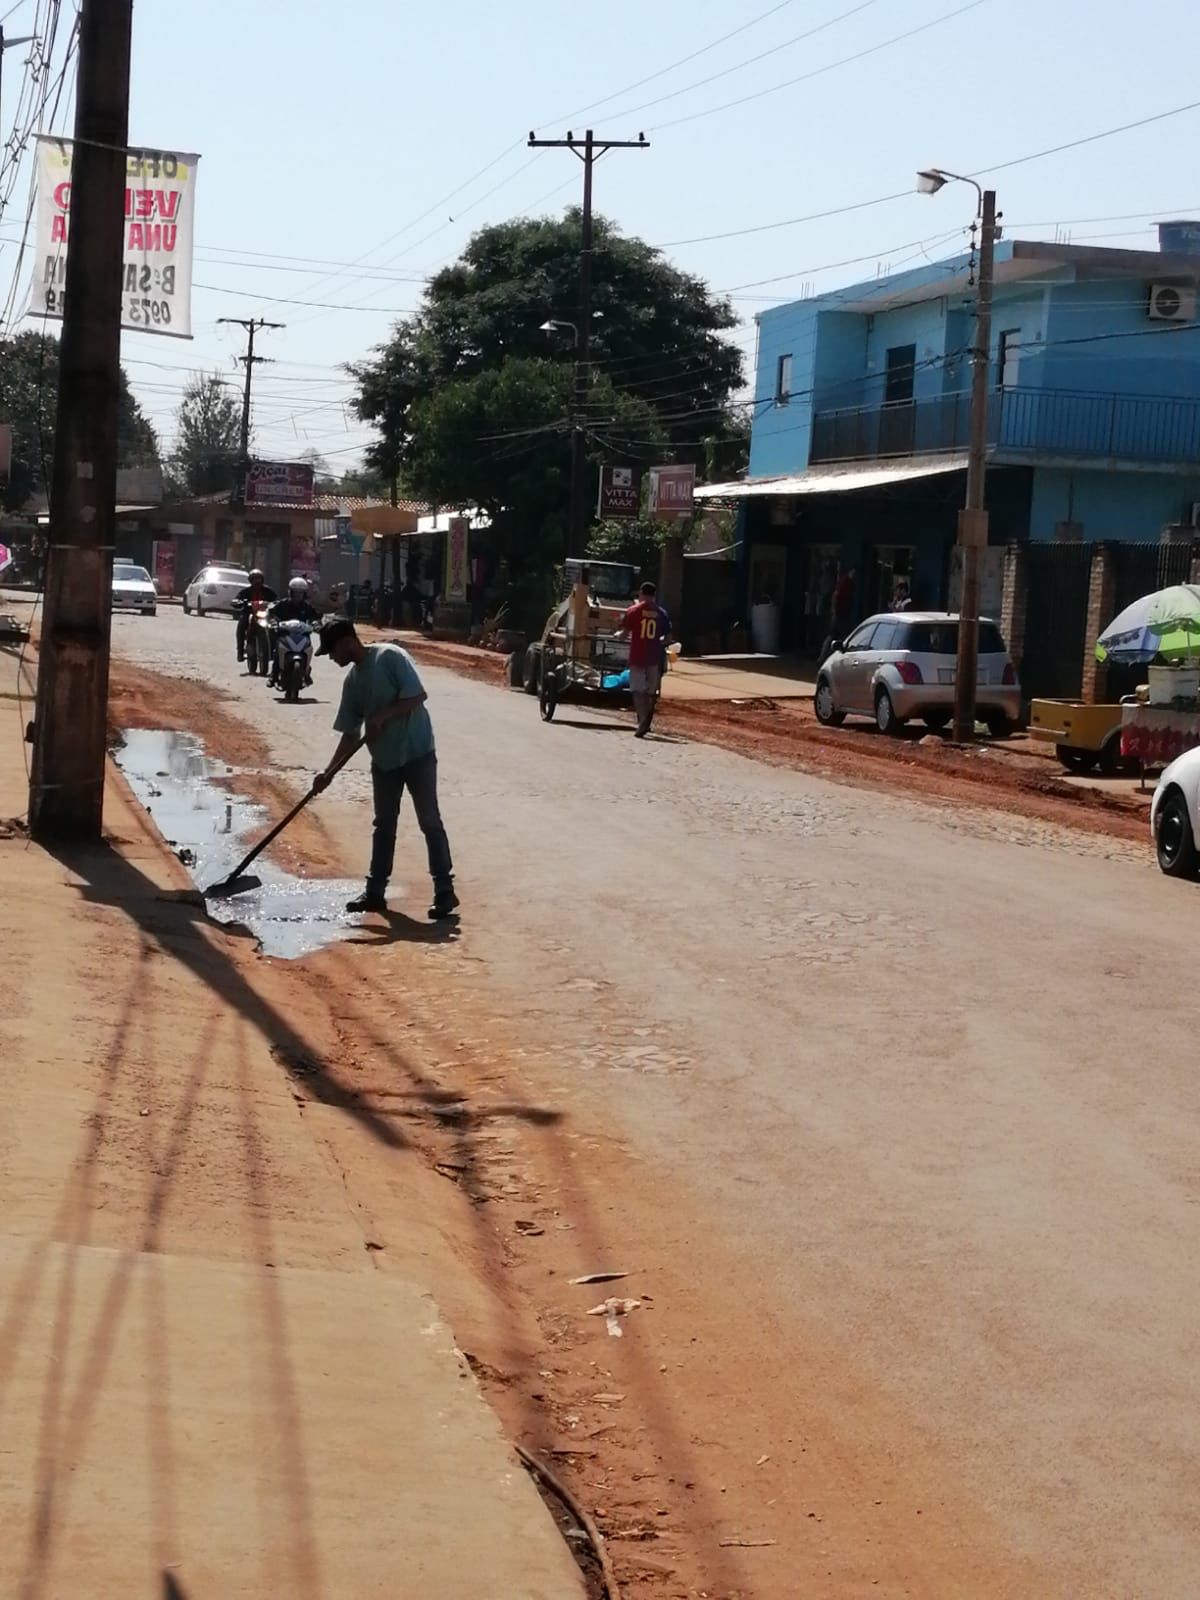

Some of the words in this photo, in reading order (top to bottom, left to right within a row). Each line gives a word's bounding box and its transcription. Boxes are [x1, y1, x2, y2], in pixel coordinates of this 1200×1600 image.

[605, 488, 637, 498] VITTA
[608, 498, 633, 507] MAX
[640, 618, 657, 640] 10
